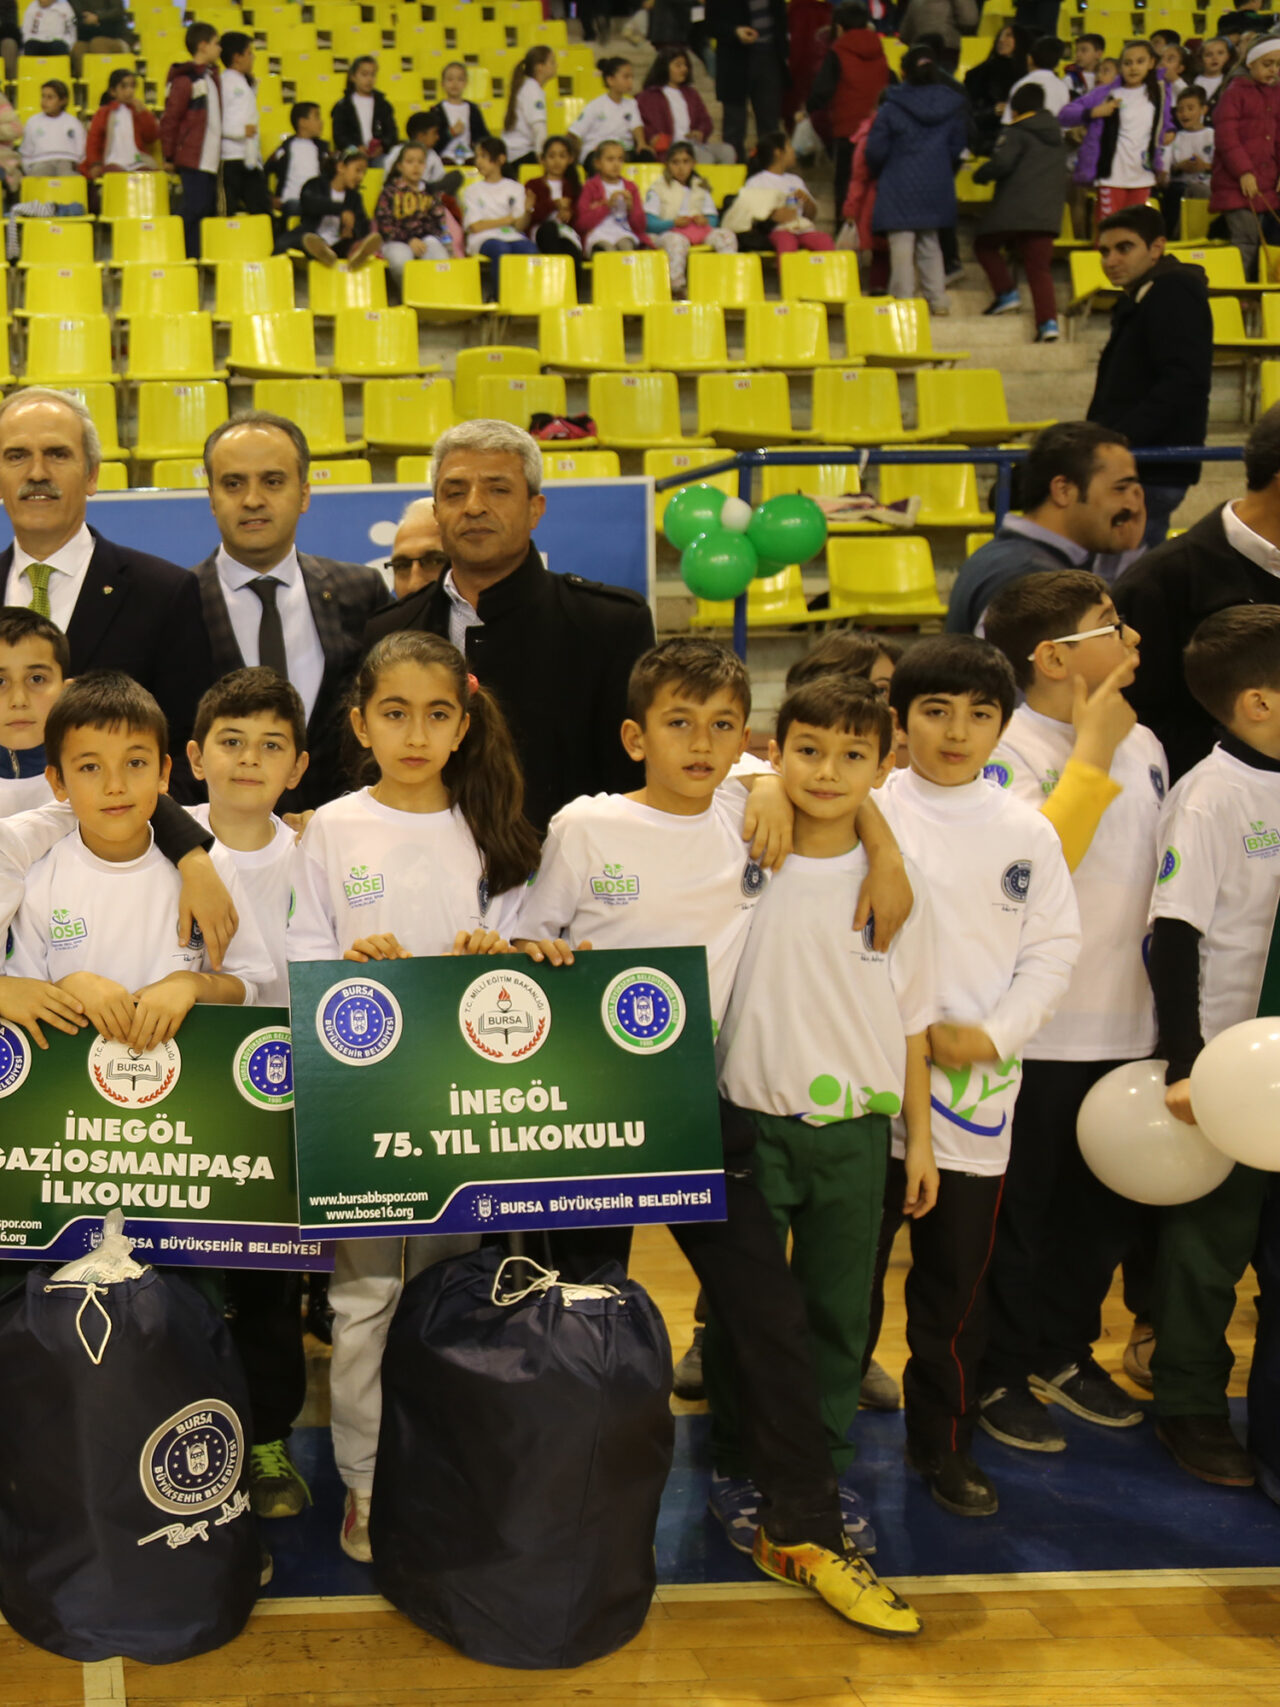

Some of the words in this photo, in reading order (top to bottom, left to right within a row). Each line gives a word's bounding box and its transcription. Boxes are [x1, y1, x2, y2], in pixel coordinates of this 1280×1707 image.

[593, 879, 636, 893] BOSE
[342, 986, 374, 998] BURSA
[488, 1015, 522, 1025] BURSA
[117, 1063, 151, 1072] BURSA
[449, 1080, 567, 1115] İNEGÖL
[65, 1110, 193, 1145] İNEGÖL
[373, 1132, 423, 1158] 75.
[431, 1129, 480, 1155] YIL
[490, 1120, 645, 1152] İLKOKULU
[41, 1174, 211, 1209] İLKOKULU
[309, 1190, 429, 1207] www.bursabbspor.com
[500, 1200, 544, 1214] BURSA
[549, 1193, 634, 1212] BÜYÜKŞEHİR
[638, 1188, 711, 1207] BELEDİYESİ
[326, 1205, 414, 1221] www.bose16.org
[130, 1238, 154, 1249] RSA
[160, 1236, 243, 1255] BÜYÜKŞEHİR
[248, 1239, 321, 1256] BELEDİYESİ
[176, 1412, 213, 1435] BURSA
[154, 1466, 203, 1503] BÜYÜKŞEHİR
[204, 1438, 238, 1499] BELEDİYESİ
